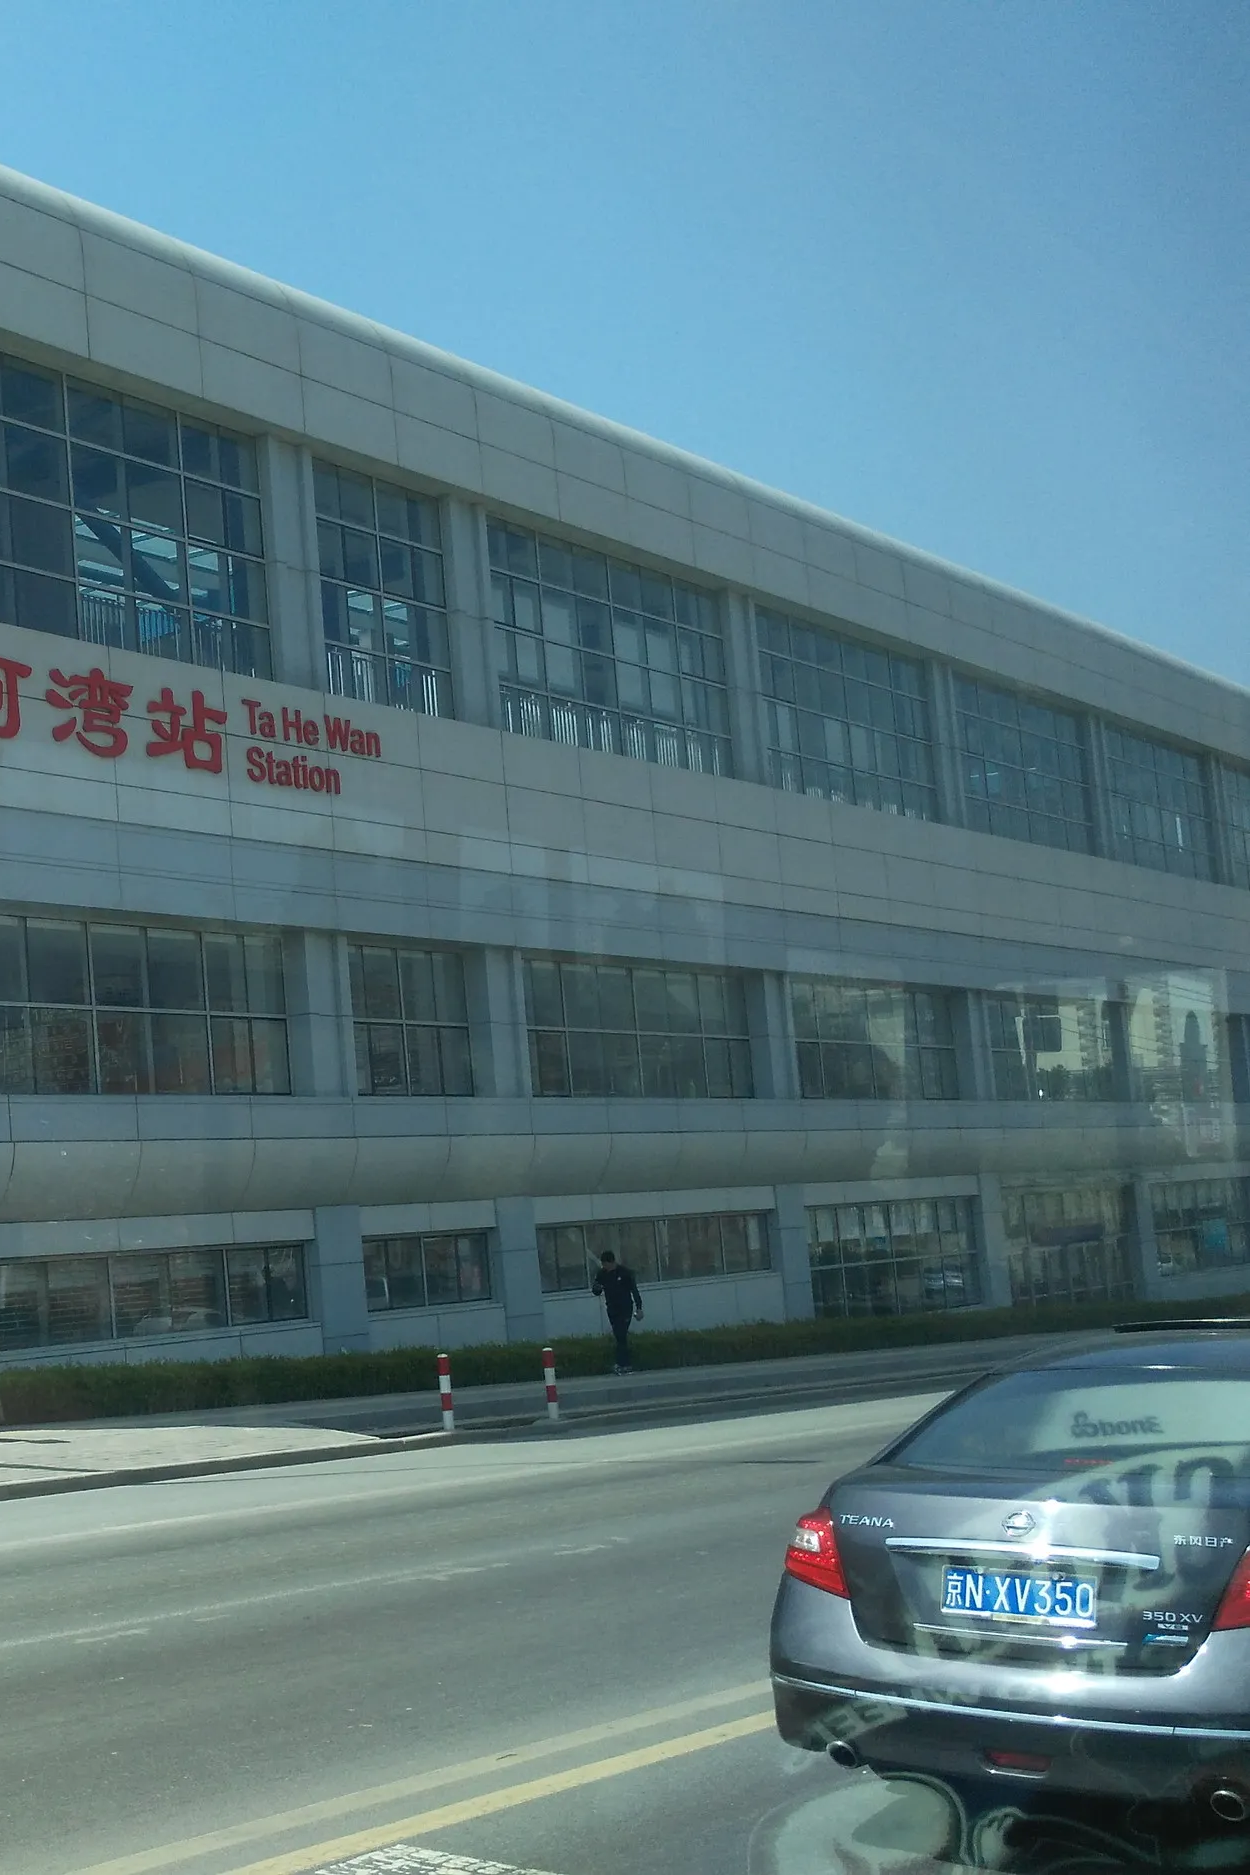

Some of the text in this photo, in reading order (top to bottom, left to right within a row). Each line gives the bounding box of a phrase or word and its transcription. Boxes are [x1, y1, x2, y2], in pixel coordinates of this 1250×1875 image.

[241, 698, 382, 758] Ta He Wan
[246, 745, 341, 795] Station
[839, 1514, 894, 1528] TEANA
[1173, 1534, 1234, 1548] 东风日产
[1142, 1610, 1203, 1623] 350 XV
